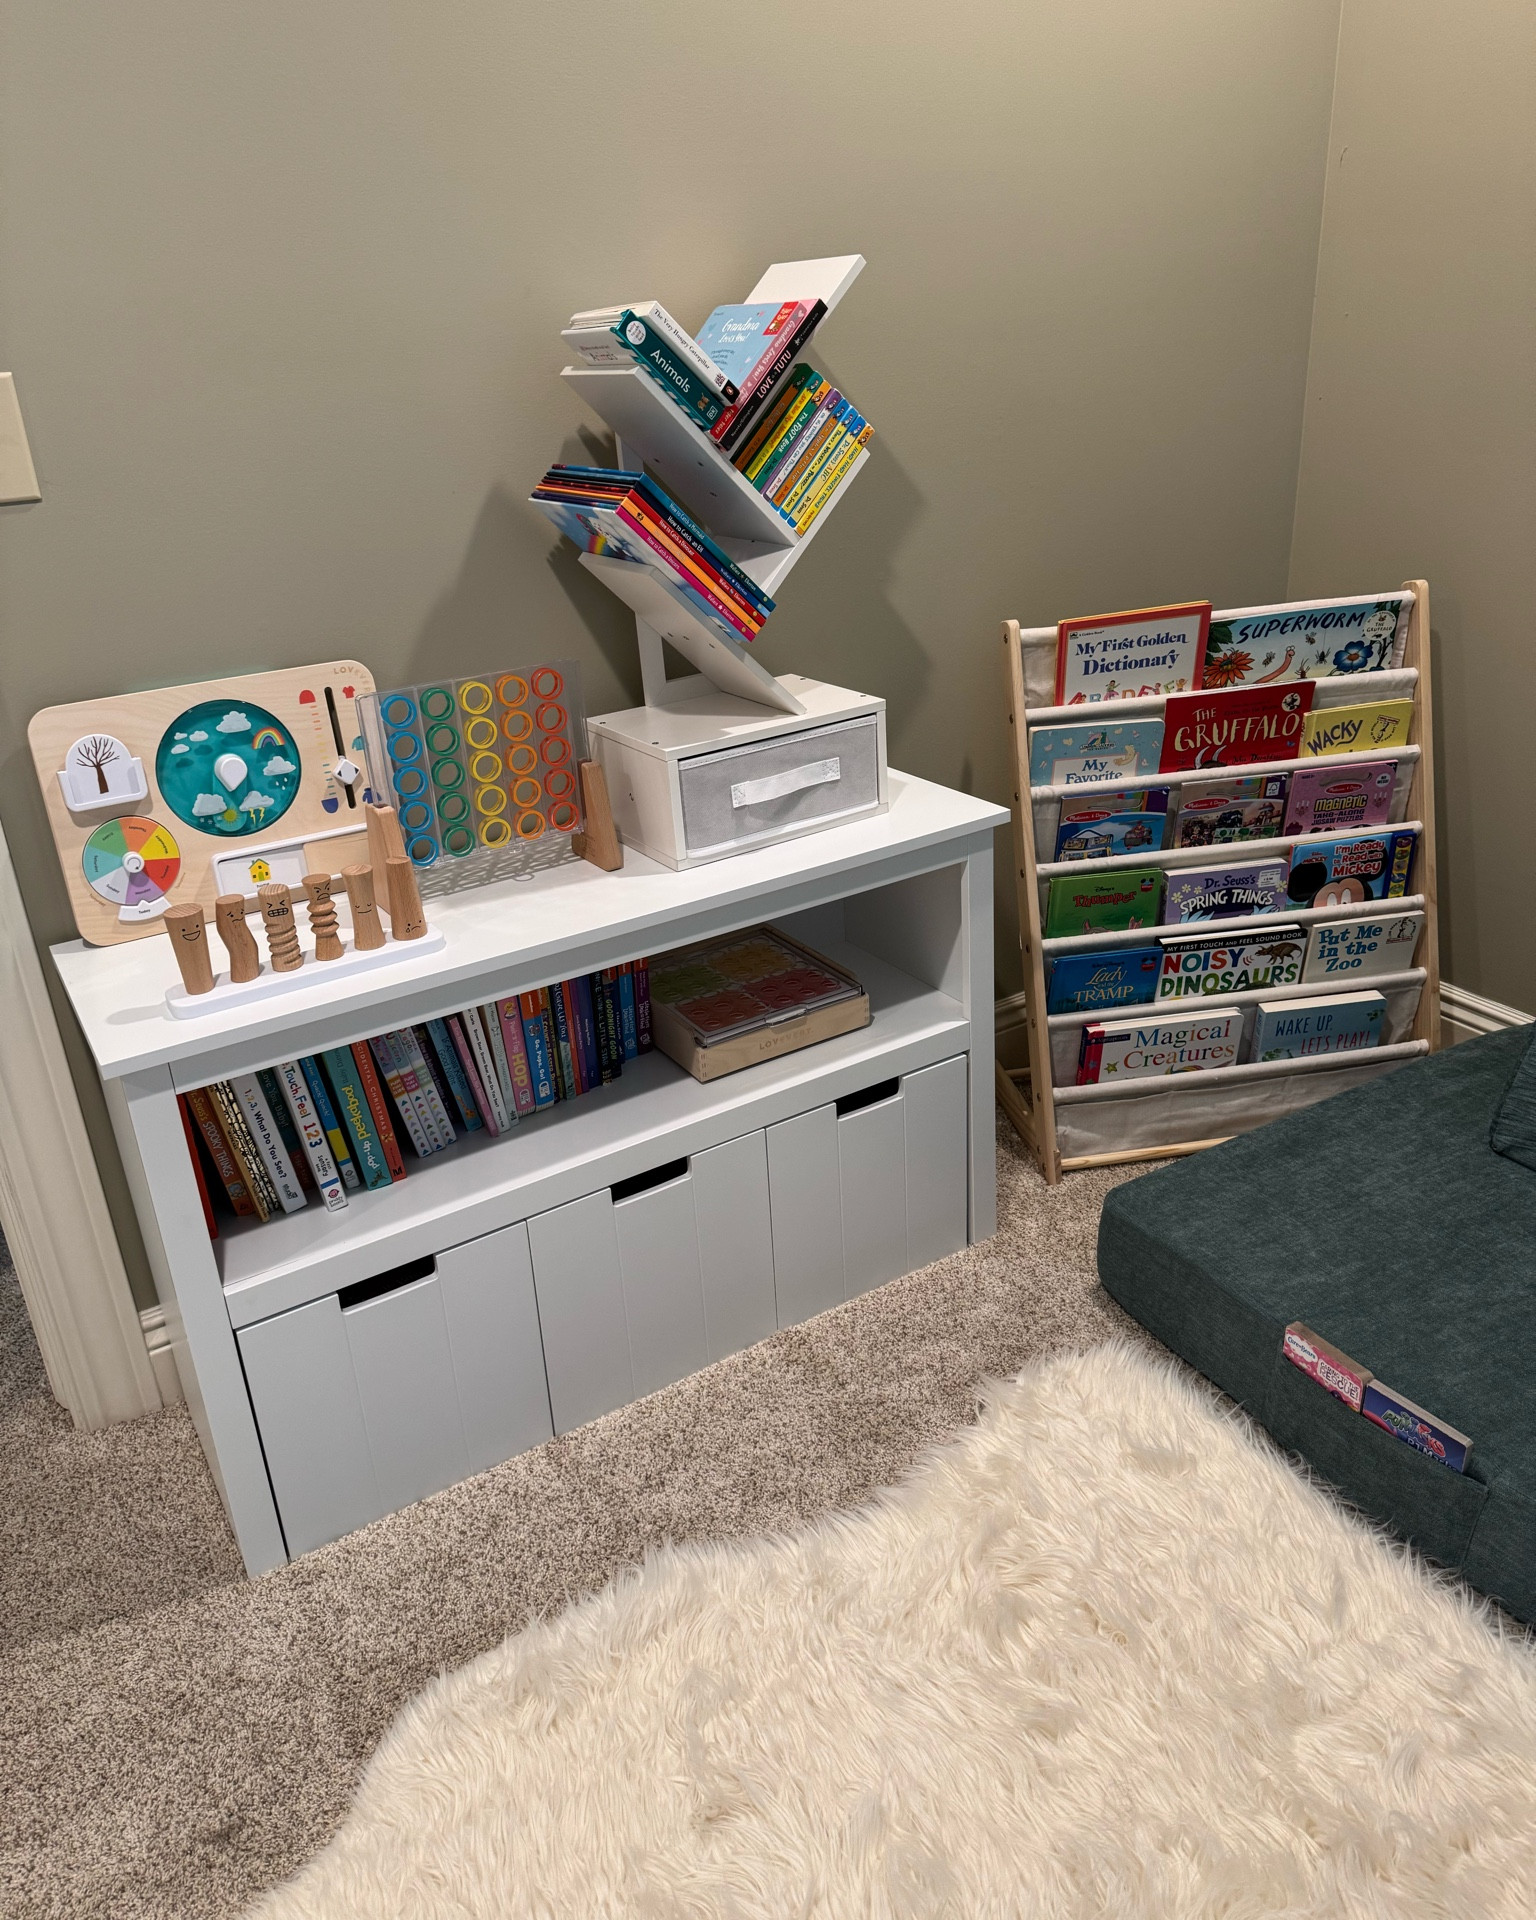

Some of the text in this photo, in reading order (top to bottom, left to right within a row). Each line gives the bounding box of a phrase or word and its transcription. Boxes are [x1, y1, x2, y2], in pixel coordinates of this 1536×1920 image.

[722, 317, 760, 333] Grandma
[773, 319, 798, 350] Grandma
[654, 308, 710, 370] The Very Hungry Caterpillar
[761, 346, 778, 367] Loves
[650, 349, 691, 393] Animals
[750, 363, 766, 381] You!
[755, 349, 793, 399] LOVE TUTU
[786, 421, 802, 440] FOOT
[815, 445, 831, 465] WOCKET
[763, 463, 774, 476] Seuss
[798, 469, 814, 490] POCKET!
[813, 446, 860, 509] HAND, HAND, THUMB
[819, 463, 834, 482] ABC
[768, 482, 779, 496] Seuss
[775, 491, 786, 504] Seuss
[784, 496, 796, 509] Seuss
[796, 501, 808, 515] Seuss
[668, 503, 678, 513] How
[679, 513, 691, 525] Catch
[690, 524, 706, 540] Mermaid
[658, 519, 669, 530] How
[669, 530, 681, 542] Catch
[679, 540, 696, 557] Dinosaur
[666, 515, 705, 553] How to Catch an Elf
[646, 536, 656, 546] How
[656, 546, 668, 558] Catch
[666, 556, 681, 570] Unicorn
[728, 562, 742, 576] Wallace
[1236, 611, 1366, 645] SUPERWORM
[1075, 631, 1189, 658] My First Golden
[1082, 649, 1180, 676] Dictionary
[1192, 707, 1217, 722] THE
[1174, 712, 1300, 752] GRUFFALO
[1306, 719, 1364, 757] WACKY
[1082, 758, 1108, 772] My
[1065, 770, 1123, 785] Favorite
[1311, 815, 1364, 826] JIGSAW PUZZLES
[1335, 846, 1351, 855] I'm
[1353, 840, 1385, 853] Ready
[1342, 852, 1368, 863] Read
[1332, 861, 1381, 877] Mickey
[1204, 877, 1221, 889] Dr.
[1222, 874, 1257, 886] Seuss's
[1072, 890, 1137, 908] Thumper
[1179, 888, 1275, 915] SPRING THINGS
[1180, 943, 1198, 951] FIRST
[1199, 941, 1224, 949] TOUCH
[1239, 937, 1253, 945] FEEL
[1255, 934, 1281, 943] SOUND
[1282, 931, 1303, 940] BOOK
[1317, 924, 1383, 945] Put Me
[1162, 947, 1246, 975] NOISY
[1317, 941, 1378, 960] in the
[1325, 957, 1363, 973] Zoo
[1085, 966, 1127, 988] Lady
[1159, 962, 1299, 997] DINOSAURS
[1073, 985, 1134, 1003] TRAMP
[554, 991, 564, 1012] Gave
[559, 1023, 568, 1038] You
[472, 1028, 481, 1042] Brown
[605, 998, 618, 1060] GOODNIGHT GOON
[1133, 1019, 1231, 1049] Magical
[1275, 1016, 1312, 1037] WAKE
[476, 1041, 484, 1052] Bear,
[598, 1021, 610, 1067] LITTLE STAR
[1300, 1030, 1371, 1055] LET'S PLAY!
[437, 1048, 458, 1086] Good Night
[444, 1043, 468, 1090] Animals Kissed
[479, 1051, 487, 1065] Brown
[533, 1038, 546, 1080] Go, Pups, Go!
[1123, 1043, 1235, 1069] Creatures
[485, 1074, 493, 1085] What
[293, 1094, 313, 1119] Feel
[340, 1084, 372, 1141] peekaboo!
[369, 1086, 389, 1131] CHRISTMAS
[492, 1098, 500, 1109] See?
[252, 1110, 269, 1133] What
[274, 1104, 291, 1128] Baby!
[192, 1096, 211, 1122] Seuss's
[202, 1119, 224, 1151] SPOOKY
[215, 1149, 236, 1178] THINGS
[262, 1132, 274, 1145] Do
[267, 1144, 280, 1161] You
[360, 1139, 381, 1171] pop-up
[273, 1159, 288, 1180] See?
[1286, 1335, 1318, 1361] Care Bears
[1318, 1366, 1361, 1401] RESCUE!
[1319, 1361, 1360, 1392] CARING TO THE
